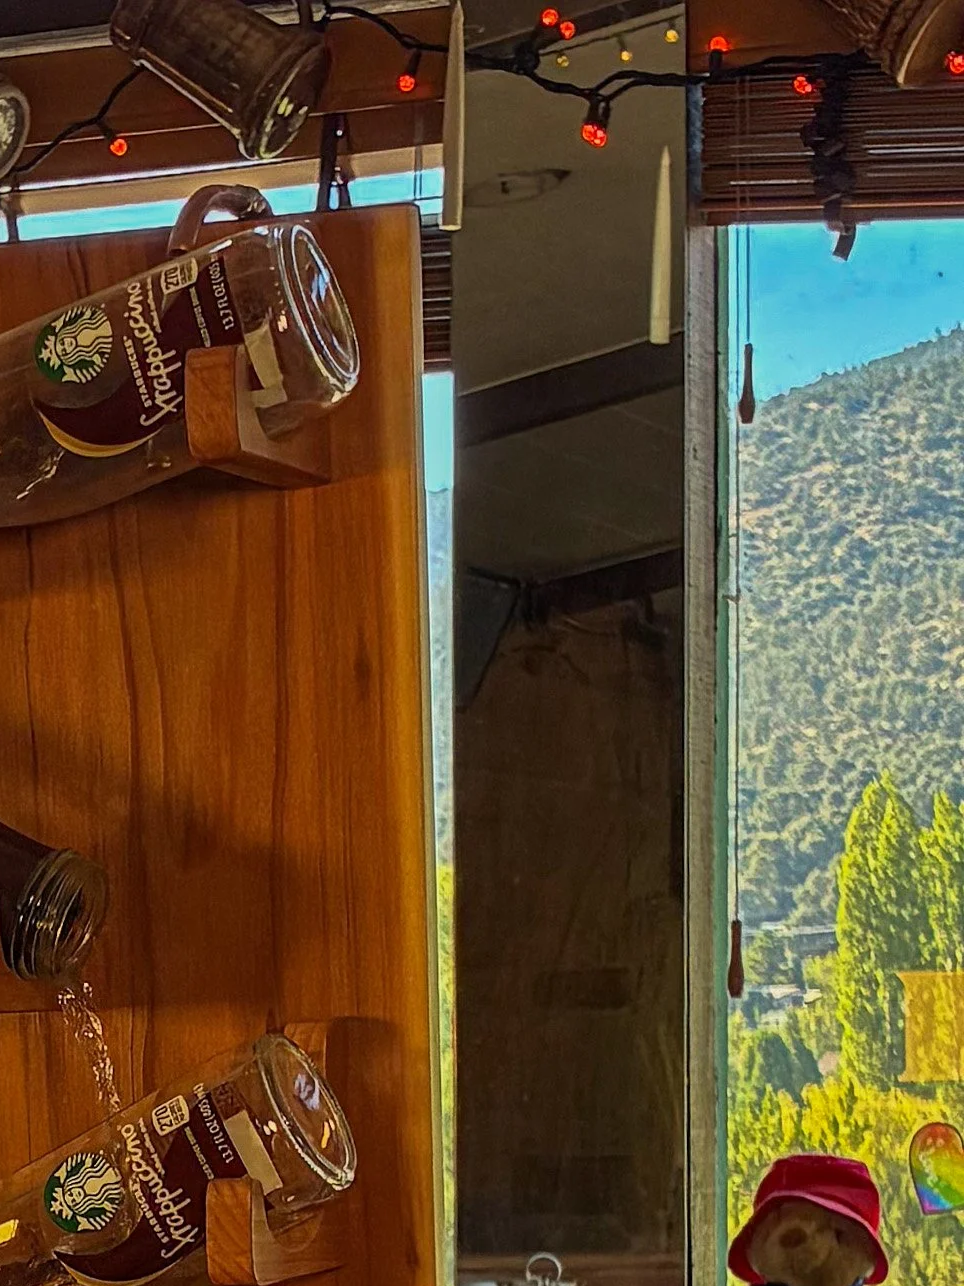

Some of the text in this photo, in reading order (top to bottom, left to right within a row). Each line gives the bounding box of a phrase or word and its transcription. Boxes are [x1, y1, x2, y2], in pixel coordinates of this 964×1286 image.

[164, 266, 180, 290] 270
[123, 338, 153, 408] STARBUCKS
[155, 1105, 174, 1132] 270
[129, 1174, 170, 1244] STARBUCKS
